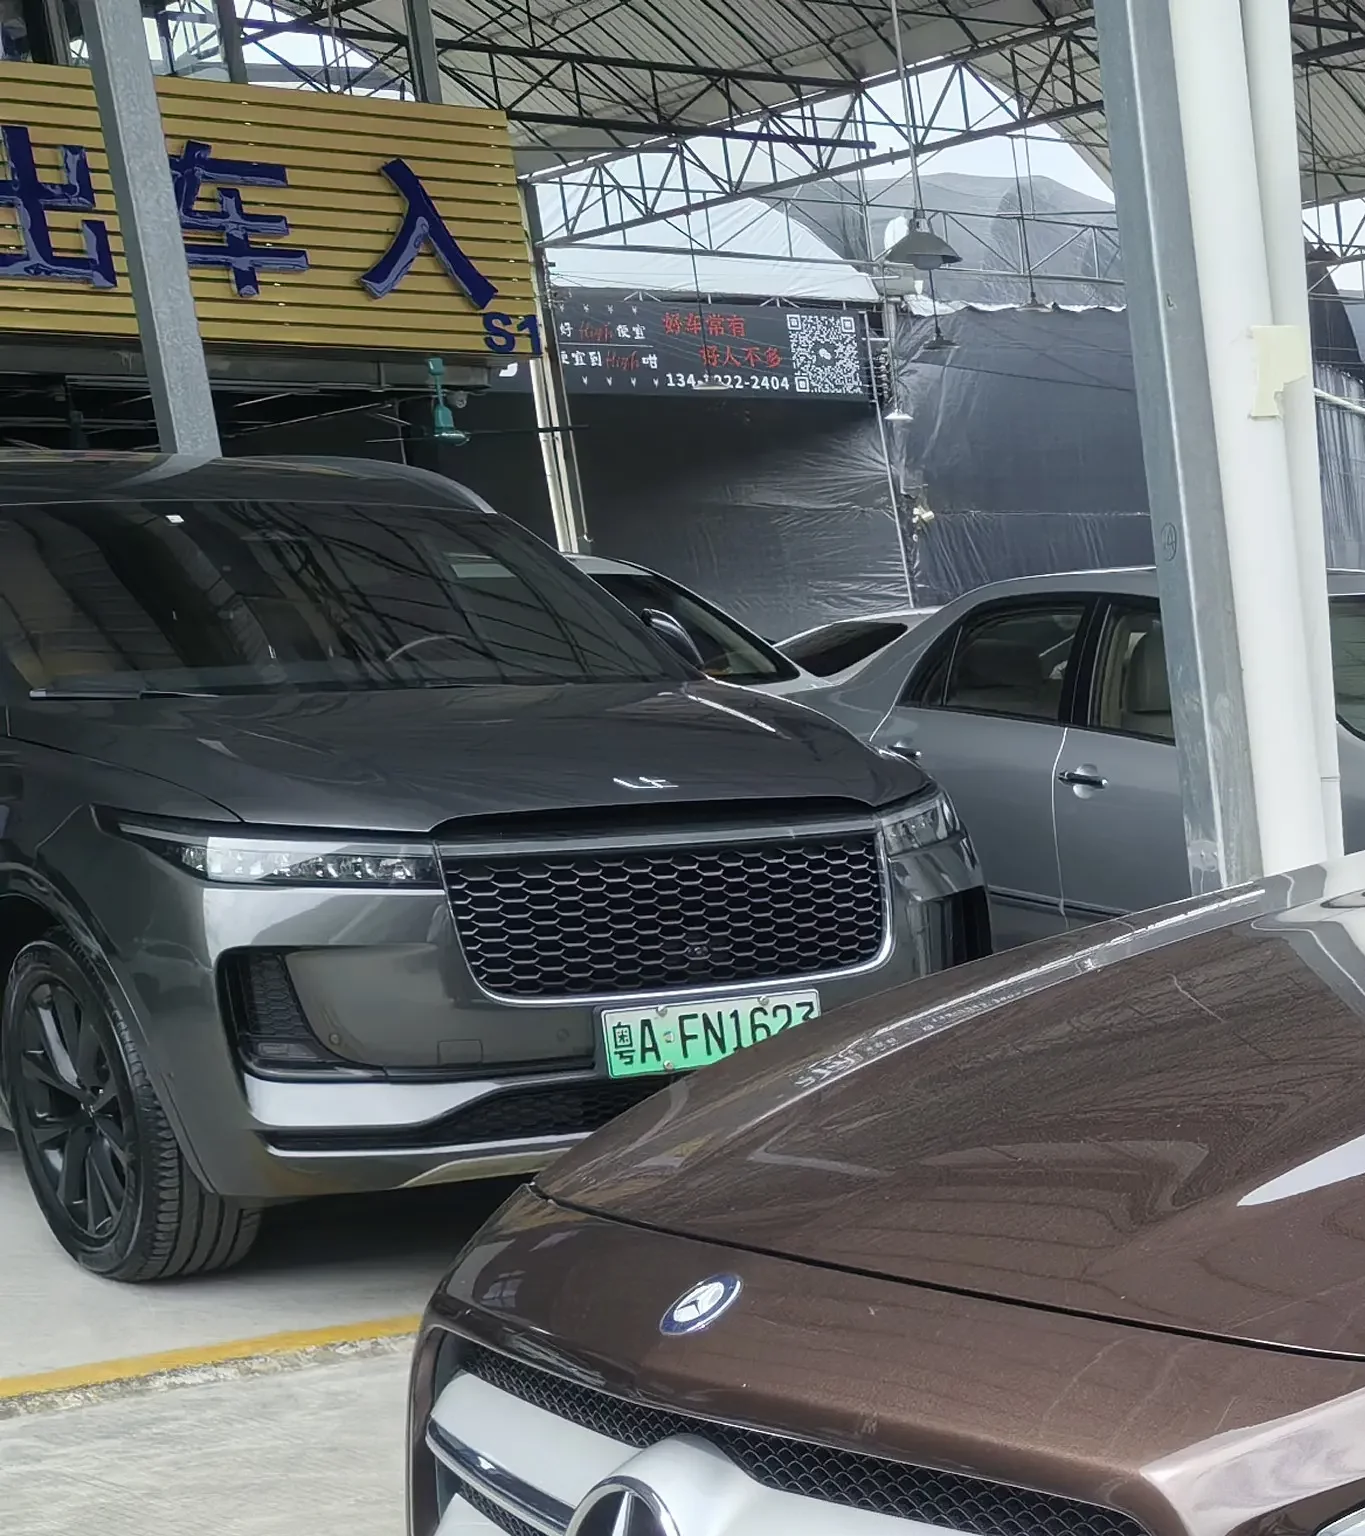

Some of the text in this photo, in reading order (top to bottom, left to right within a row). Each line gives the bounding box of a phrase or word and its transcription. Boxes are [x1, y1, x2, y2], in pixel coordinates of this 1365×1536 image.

[482, 311, 543, 358] S1
[616, 323, 646, 340] 便宜
[662, 312, 746, 337] 好车常有
[700, 345, 783, 369] 好人不多
[612, 1018, 662, 1066] 粤A
